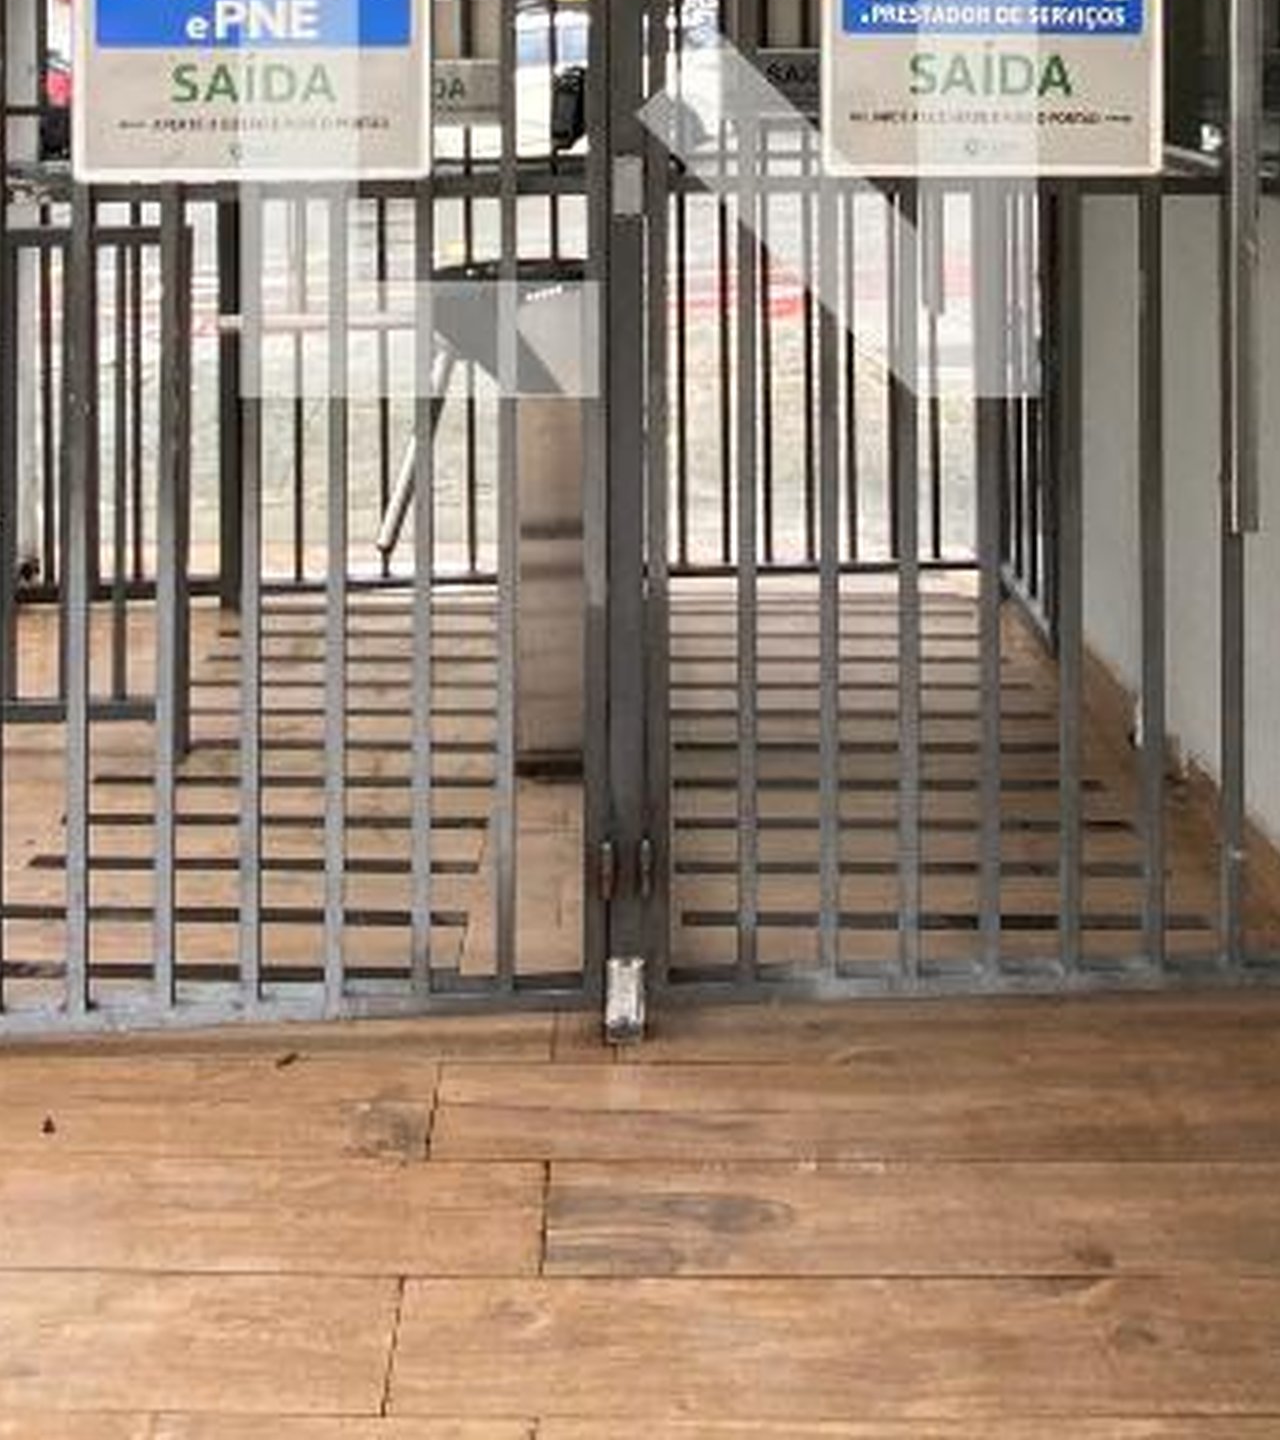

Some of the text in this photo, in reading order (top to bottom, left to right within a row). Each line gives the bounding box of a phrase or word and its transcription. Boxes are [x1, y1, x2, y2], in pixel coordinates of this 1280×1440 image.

[185, 15, 210, 40] e
[871, 4, 989, 25] PRESTADOR
[995, 6, 1025, 25] DE
[1028, 6, 1126, 30] SERVIÇOS
[171, 51, 338, 103] SAÍDA
[909, 40, 1072, 97] SAÍDA
